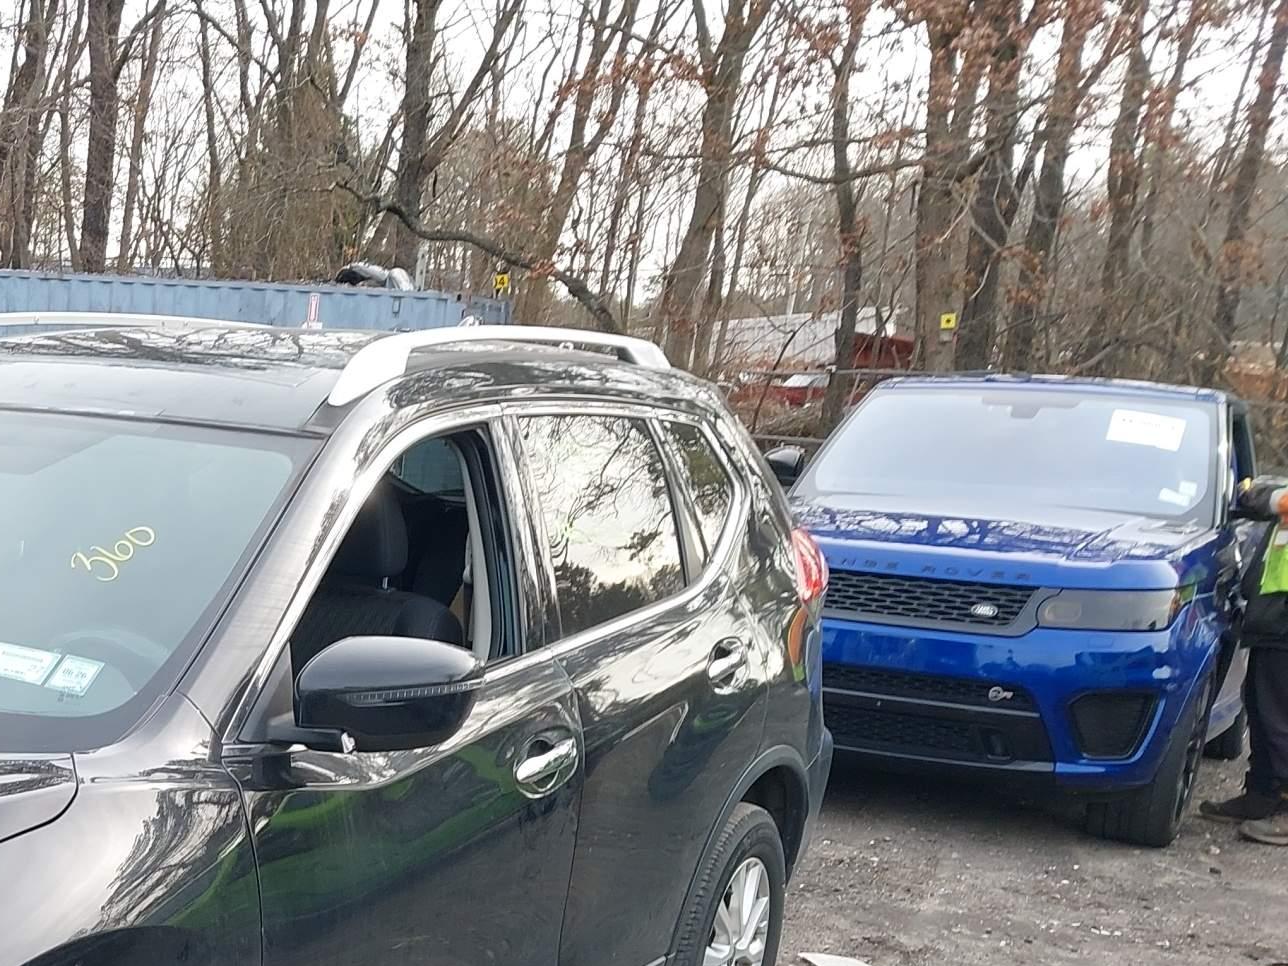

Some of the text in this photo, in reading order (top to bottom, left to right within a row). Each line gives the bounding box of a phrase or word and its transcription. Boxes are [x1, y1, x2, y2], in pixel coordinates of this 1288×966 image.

[71, 526, 155, 581] 360
[826, 556, 1032, 581] NGE ROVER
